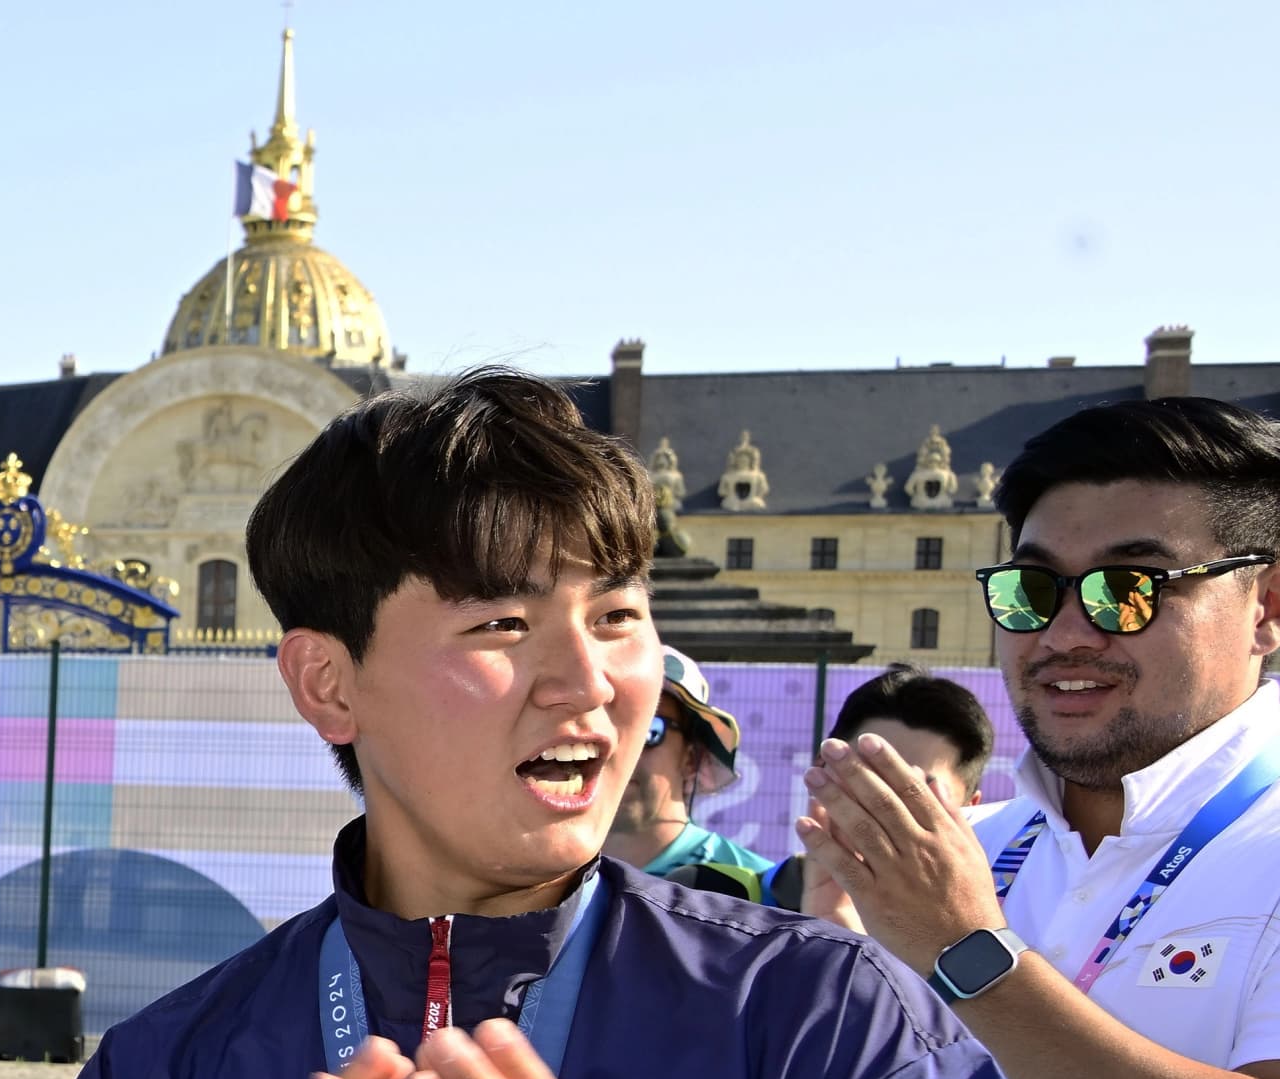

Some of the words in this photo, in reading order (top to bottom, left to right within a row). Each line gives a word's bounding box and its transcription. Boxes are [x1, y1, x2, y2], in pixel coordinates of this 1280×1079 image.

[1159, 846, 1192, 879] Atos
[328, 972, 351, 1039] 2024
[427, 1002, 441, 1030] 2024
